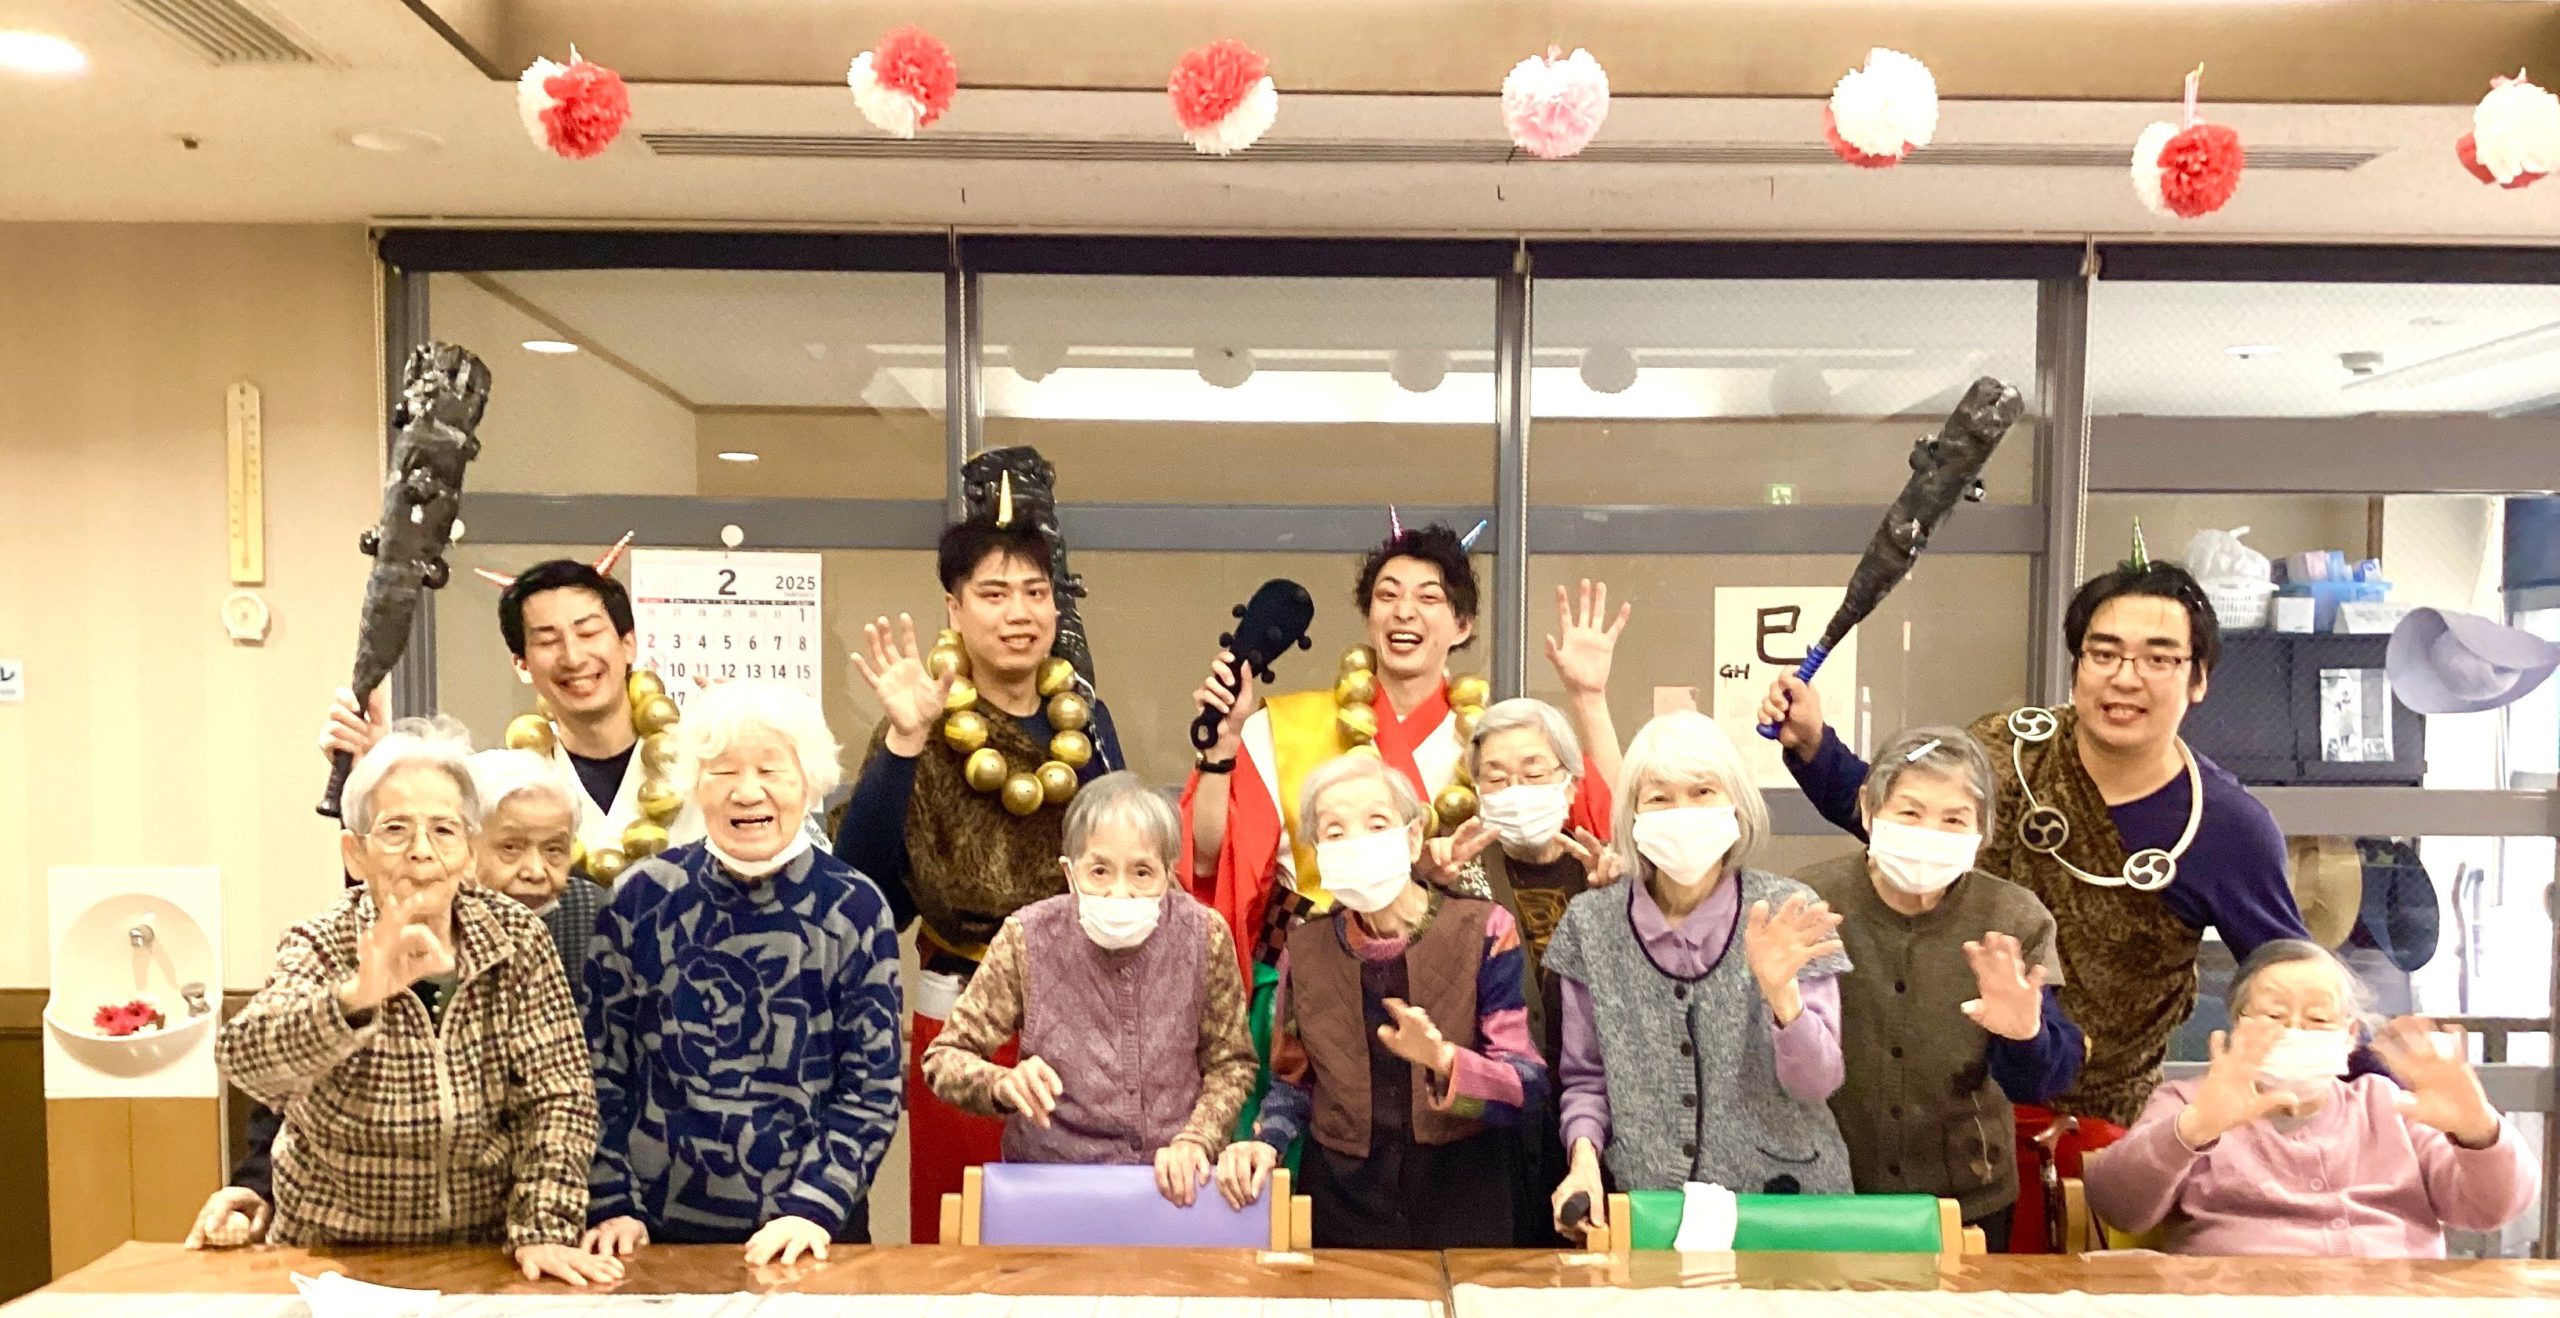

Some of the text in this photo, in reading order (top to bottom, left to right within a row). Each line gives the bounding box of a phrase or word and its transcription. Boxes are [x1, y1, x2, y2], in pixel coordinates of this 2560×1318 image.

[718, 568, 737, 596] 2
[775, 575, 816, 591] 2025
[799, 607, 805, 622] 1
[647, 633, 807, 651] 2 3 4 5 6 7 8
[670, 662, 811, 680] 10 11 12 13 14 15
[1719, 663, 1750, 680] GH
